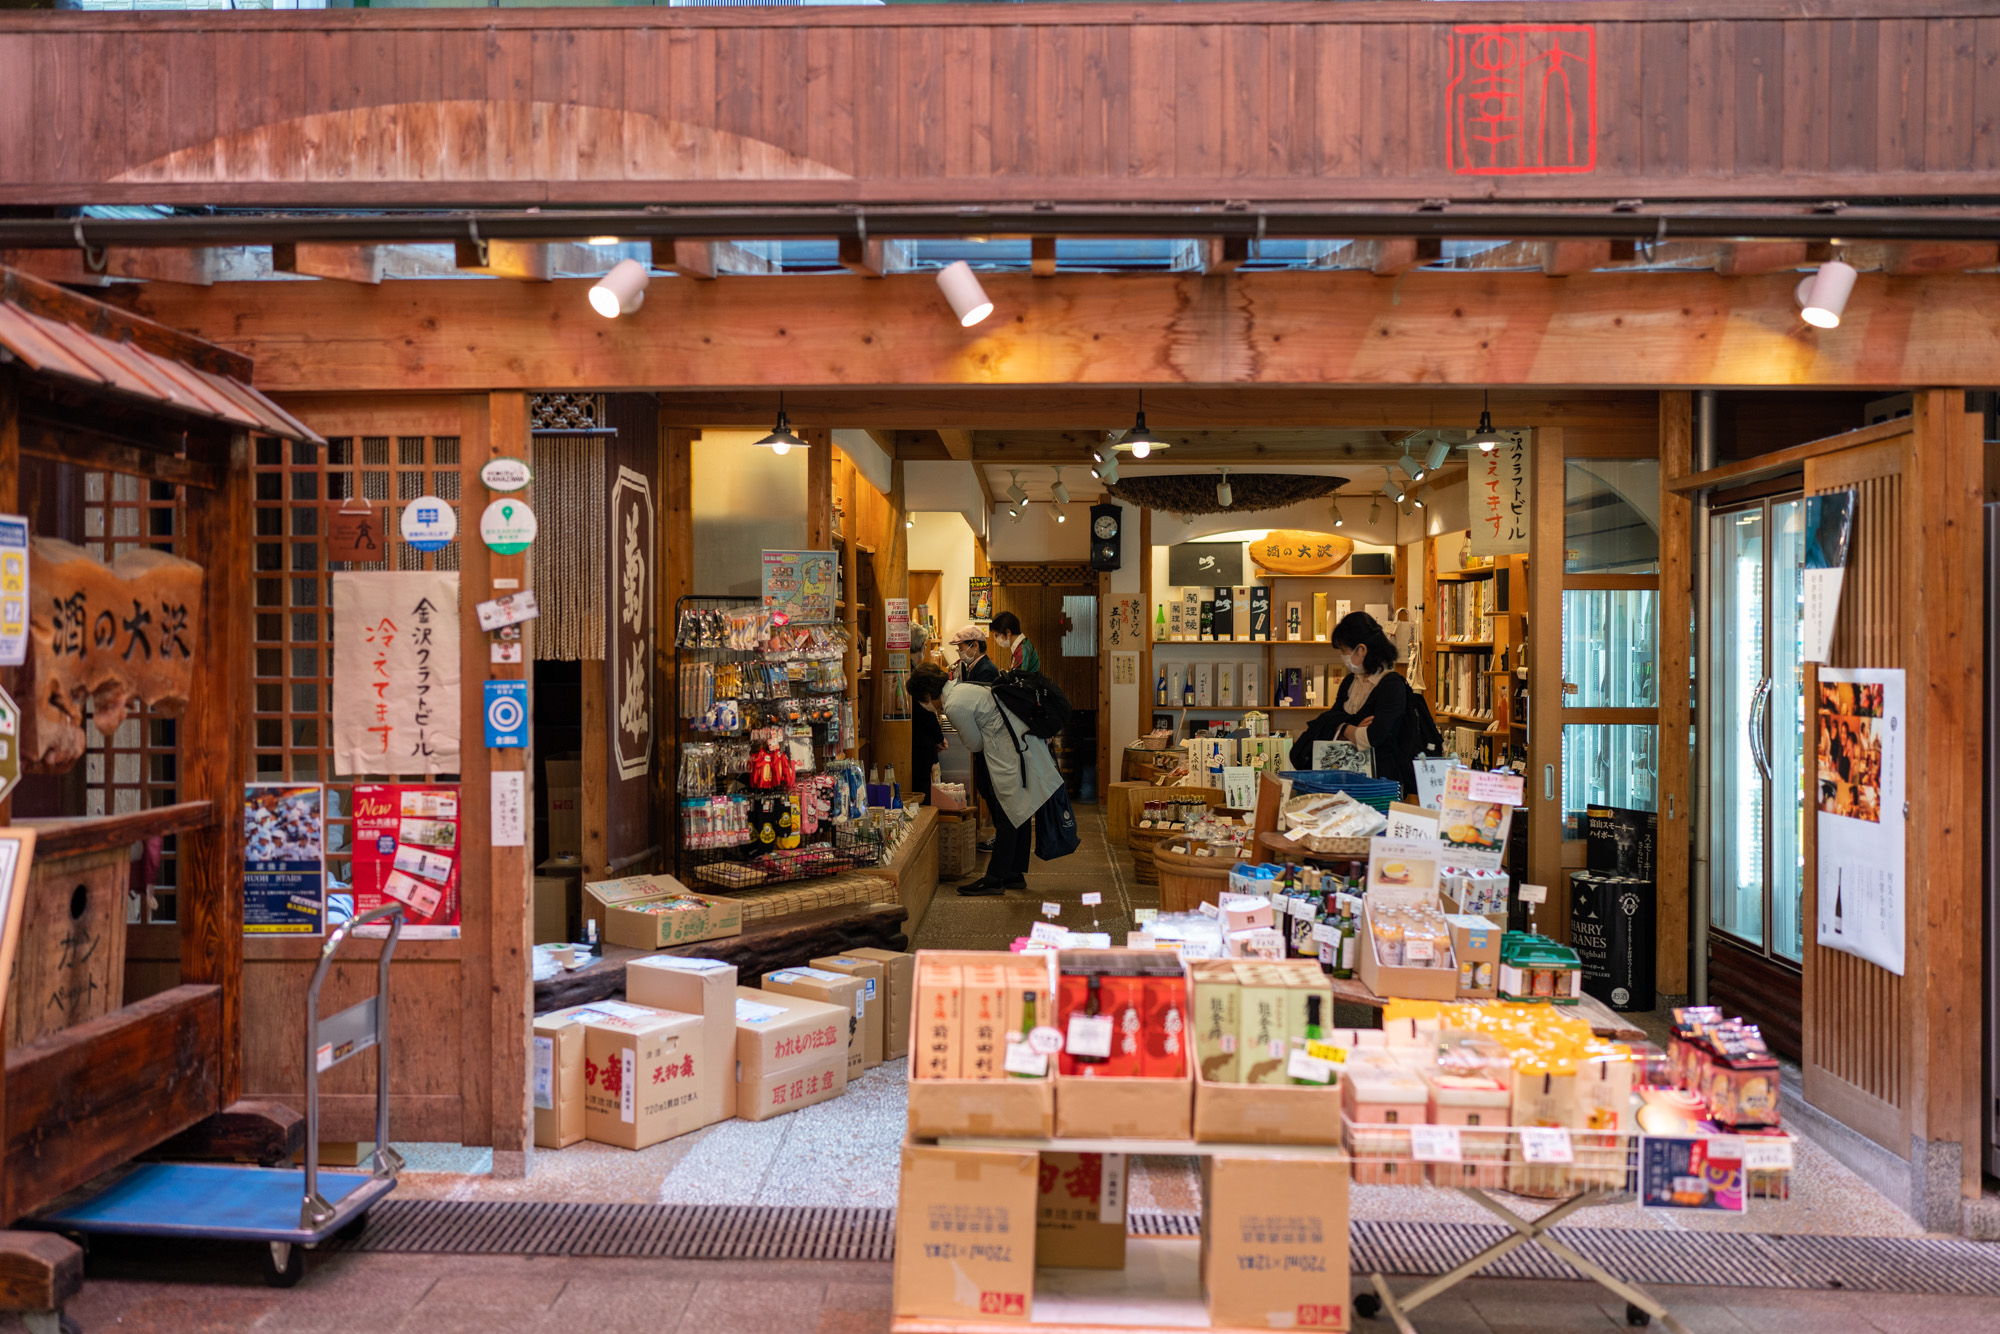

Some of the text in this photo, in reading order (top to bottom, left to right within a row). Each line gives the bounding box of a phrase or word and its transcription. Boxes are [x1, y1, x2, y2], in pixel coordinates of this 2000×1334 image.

[1267, 544, 1333, 559] 酒の大沢
[51, 591, 191, 661] 酒の大沢
[365, 616, 398, 755] 冷えてます
[410, 597, 438, 758] 金沢クラフトビール
[354, 796, 393, 818] New
[1589, 818, 1635, 833] 富山スモーキー
[1589, 830, 1621, 841] ハイボール
[1643, 834, 1652, 880] スモーキー
[1571, 919, 1604, 935] HARRY
[1571, 931, 1607, 949] RANES
[1579, 949, 1607, 960] Highball
[774, 1025, 838, 1059] われもの注意
[652, 1053, 695, 1085] 天狗舞
